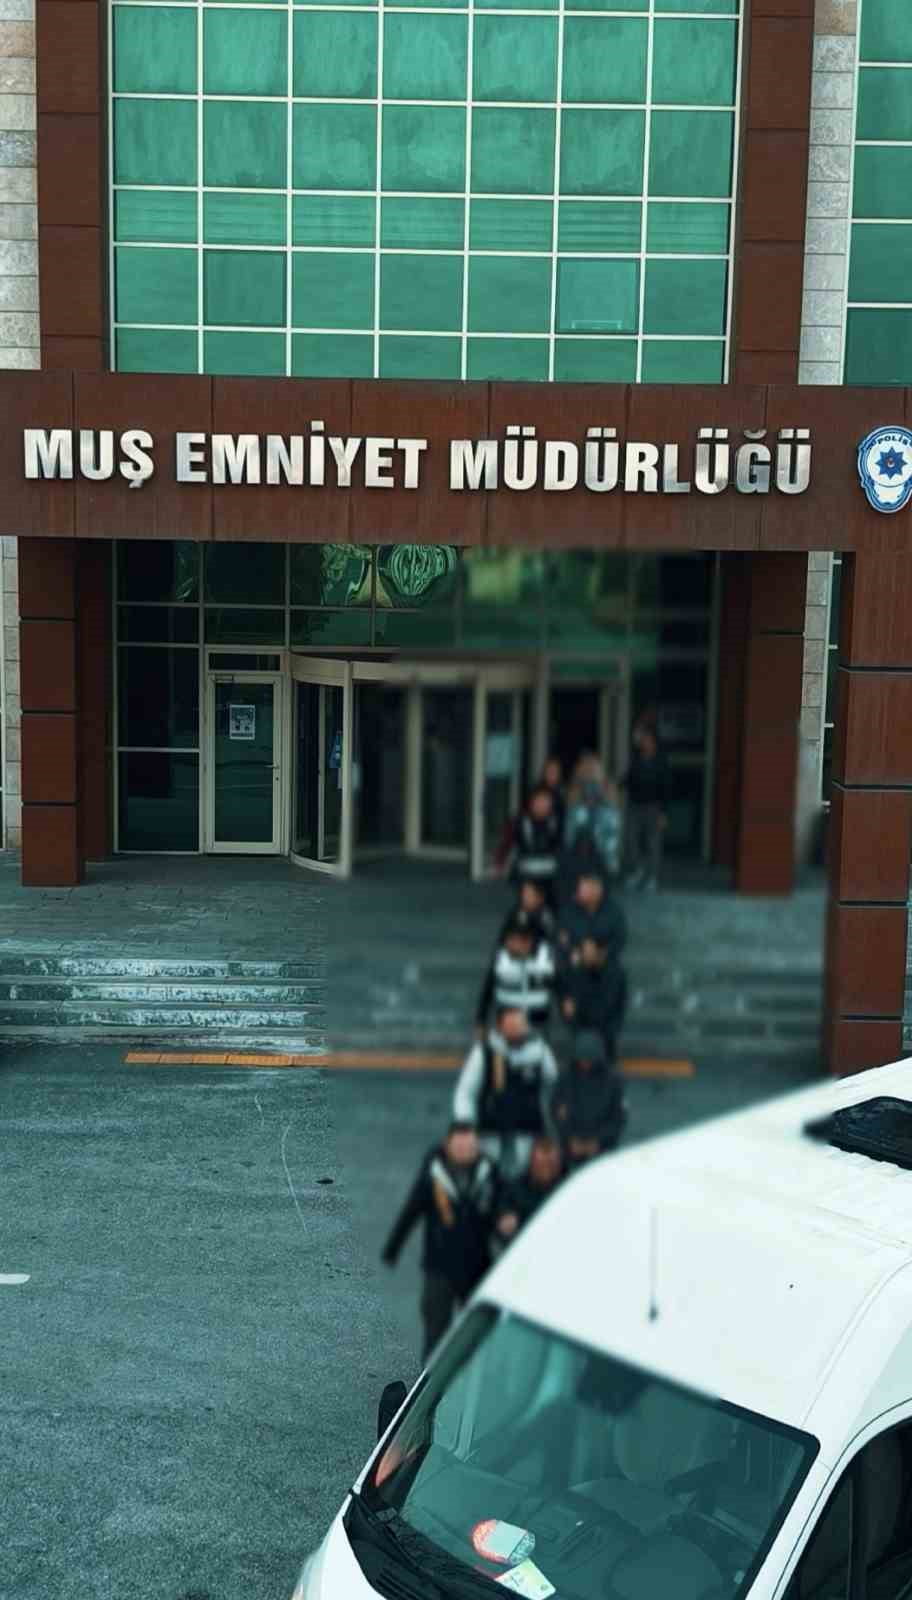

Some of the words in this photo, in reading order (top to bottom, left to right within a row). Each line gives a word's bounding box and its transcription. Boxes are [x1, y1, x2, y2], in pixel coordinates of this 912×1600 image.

[23, 428, 155, 488] MUŞ
[176, 421, 428, 489] EMNİYET
[449, 425, 812, 494] MÜDÜRLÜĞÜ
